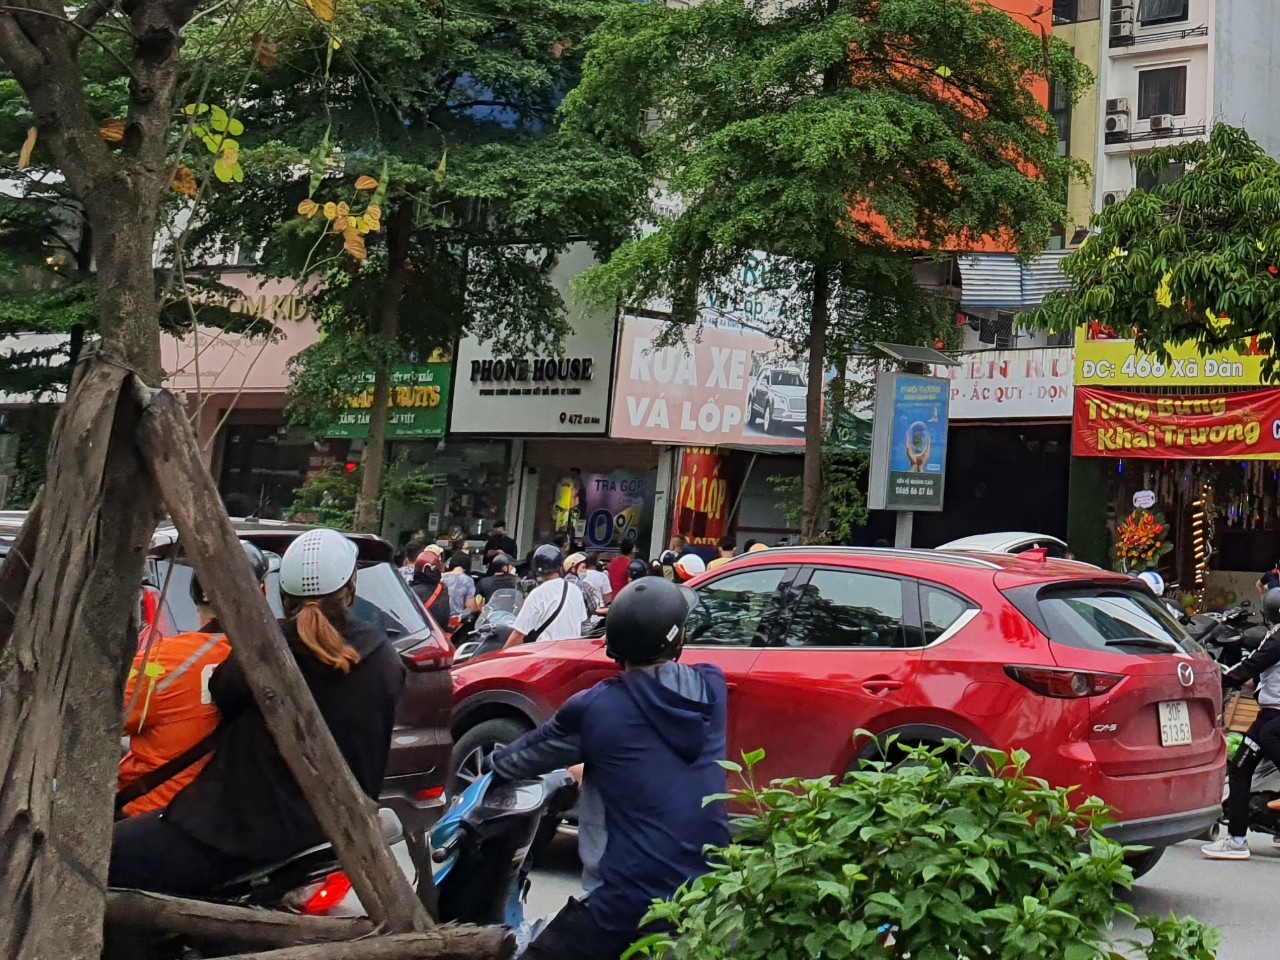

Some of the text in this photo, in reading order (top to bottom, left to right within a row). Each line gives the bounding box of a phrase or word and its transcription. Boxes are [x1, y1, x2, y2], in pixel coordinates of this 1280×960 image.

[470, 357, 593, 381] PHONE HOUSE
[705, 346, 747, 390] XE
[1082, 360, 1116, 378] ĐC:
[1120, 354, 1166, 379] 468
[1204, 357, 1243, 378] Đàn
[994, 386, 1024, 403] QUY
[1037, 385, 1068, 403] DỌN
[568, 414, 583, 424] 472
[626, 393, 742, 433] VÁ LỐP
[1097, 426, 1157, 451] Khai
[1166, 703, 1181, 721] 30F
[1093, 723, 1118, 732] CX-5
